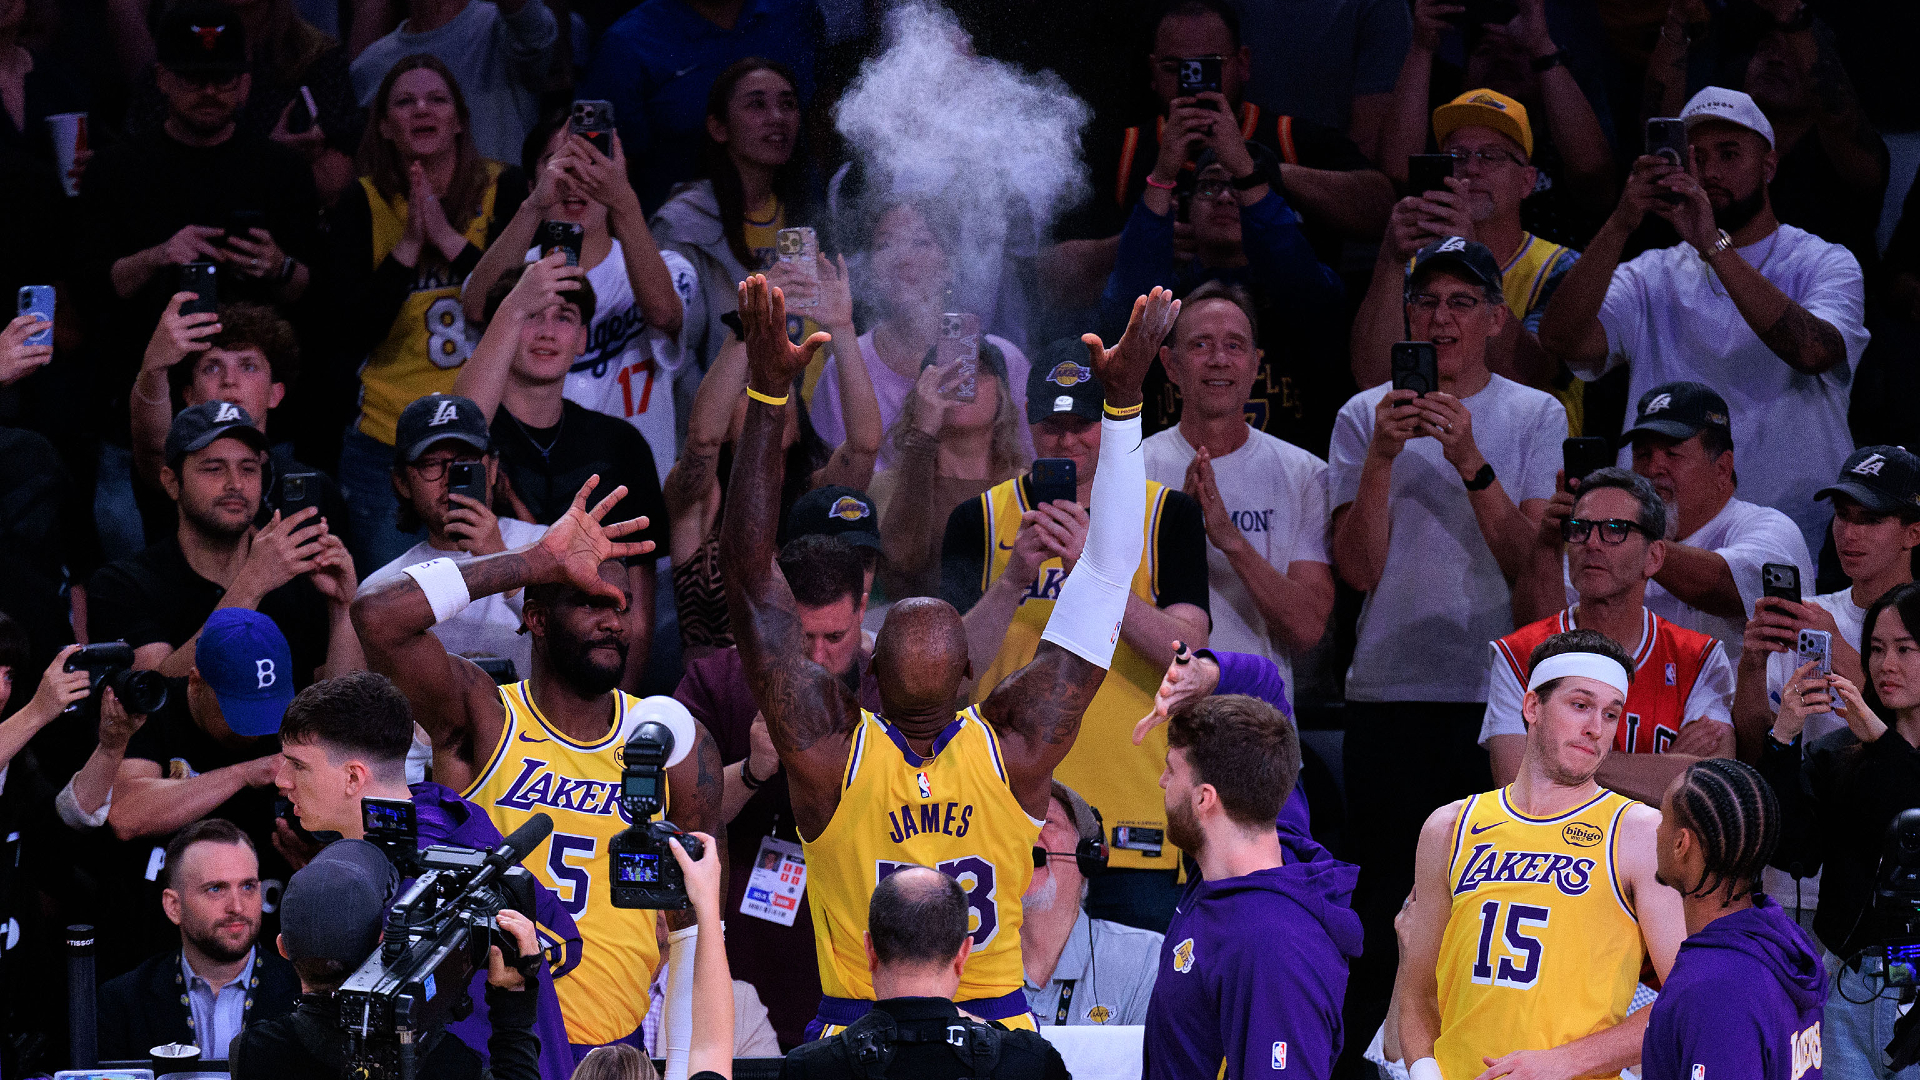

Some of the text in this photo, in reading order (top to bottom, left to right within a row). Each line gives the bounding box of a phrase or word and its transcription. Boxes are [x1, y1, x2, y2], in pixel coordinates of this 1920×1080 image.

[425, 296, 468, 370] 8
[618, 359, 655, 417] 17
[256, 658, 277, 689] B
[494, 756, 633, 826] LAKER
[888, 802, 974, 844] JAMES
[1566, 826, 1601, 842] bibigo
[546, 831, 598, 921] 5
[1453, 842, 1598, 897] LAKERS
[876, 855, 1000, 953] 3
[69, 938, 94, 947] TISSOT
[1471, 899, 1551, 991] 15
